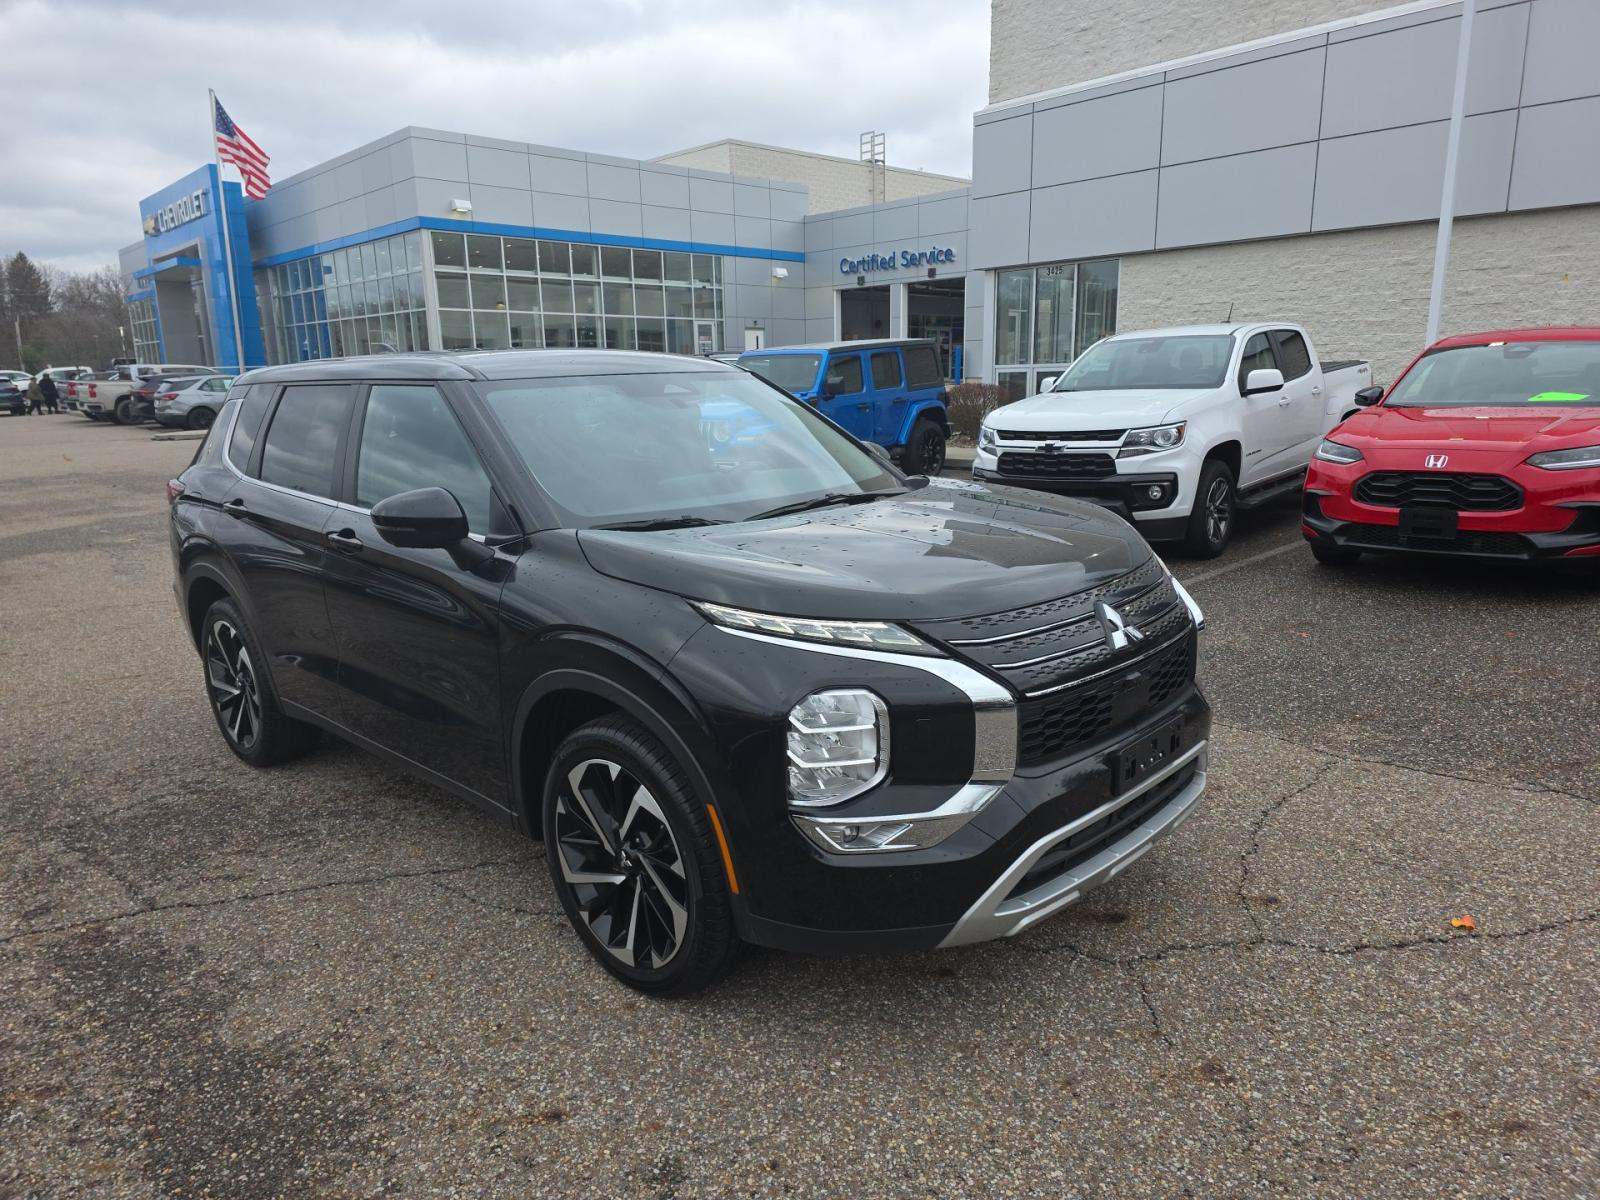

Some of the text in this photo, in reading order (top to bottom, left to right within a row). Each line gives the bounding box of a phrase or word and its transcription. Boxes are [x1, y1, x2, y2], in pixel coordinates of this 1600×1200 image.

[157, 189, 204, 232] CHEVROLET
[840, 246, 954, 274] Certified Service
